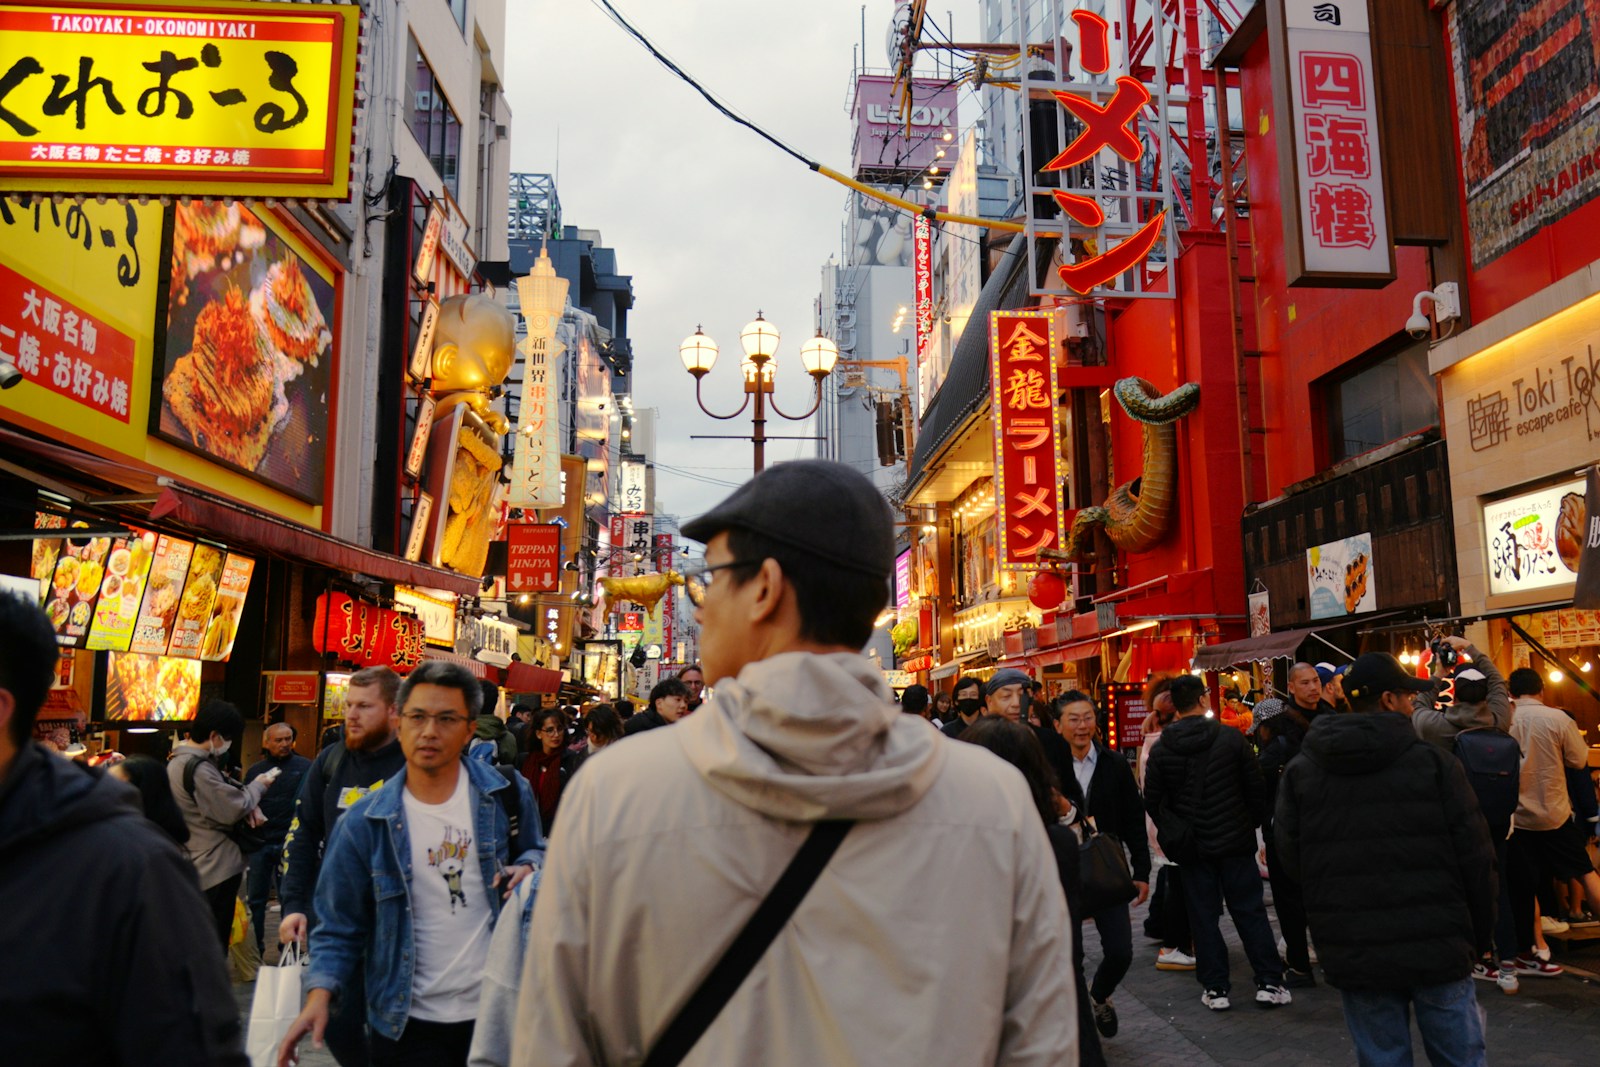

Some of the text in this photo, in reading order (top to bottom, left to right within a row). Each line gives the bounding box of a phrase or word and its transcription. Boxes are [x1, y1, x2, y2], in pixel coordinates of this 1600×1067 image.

[1313, 3, 1341, 26] 司
[0, 43, 308, 136] くれおーる
[31, 146, 250, 165] 大阪名物 たこ焼・お好み焼
[1299, 50, 1376, 250] 四海樓
[22, 288, 97, 355] 大阪名物
[1512, 367, 1556, 416] Toki
[1516, 412, 1555, 437] escape
[1555, 397, 1582, 422] cafe
[1002, 320, 1057, 558] 金龍ラーメン
[509, 558, 551, 569] JINJYA
[510, 544, 557, 554] TEPPAN
[526, 576, 539, 586] B1
